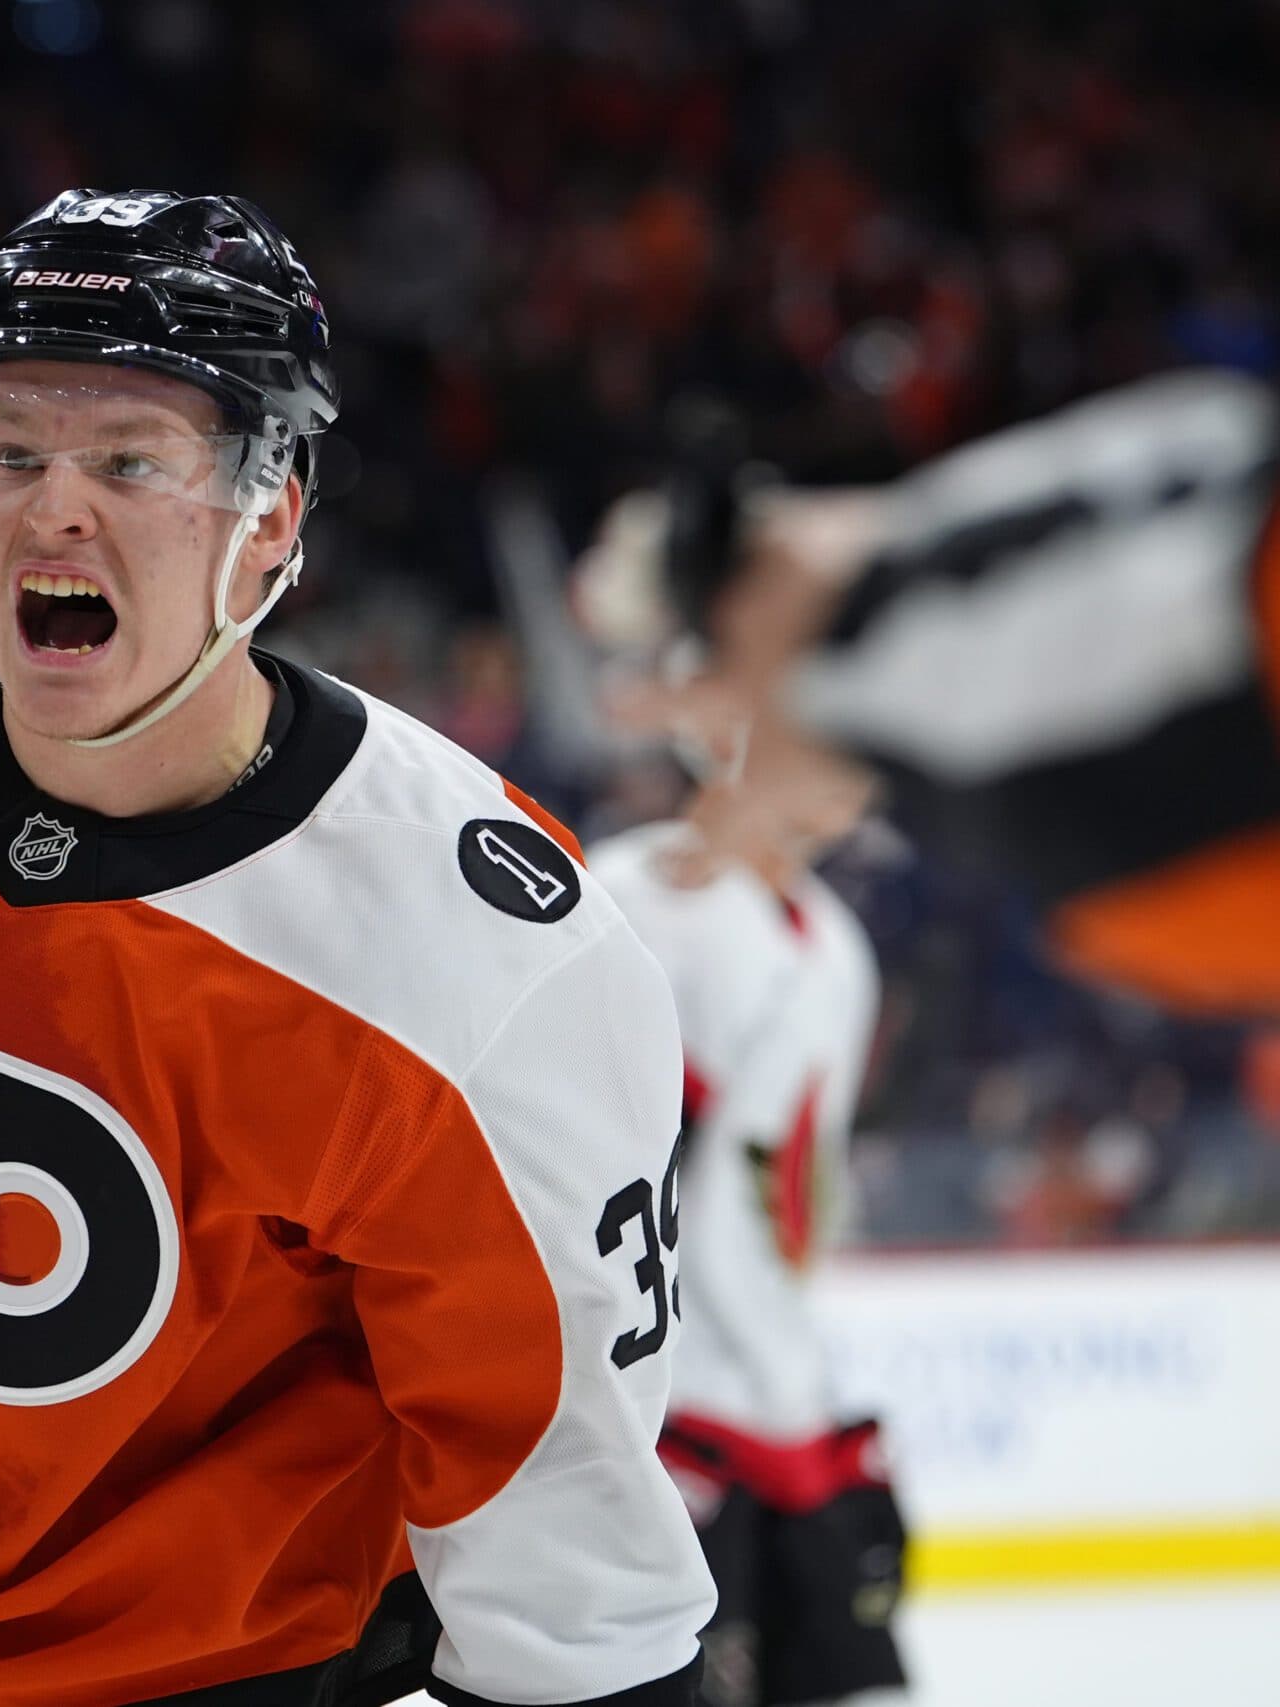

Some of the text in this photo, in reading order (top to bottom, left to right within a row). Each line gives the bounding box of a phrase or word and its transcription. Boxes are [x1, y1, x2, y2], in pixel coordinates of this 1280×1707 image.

[60, 197, 153, 228] 39
[12, 270, 133, 292] BAUER
[19, 839, 62, 860] NHL
[476, 827, 567, 912] 1
